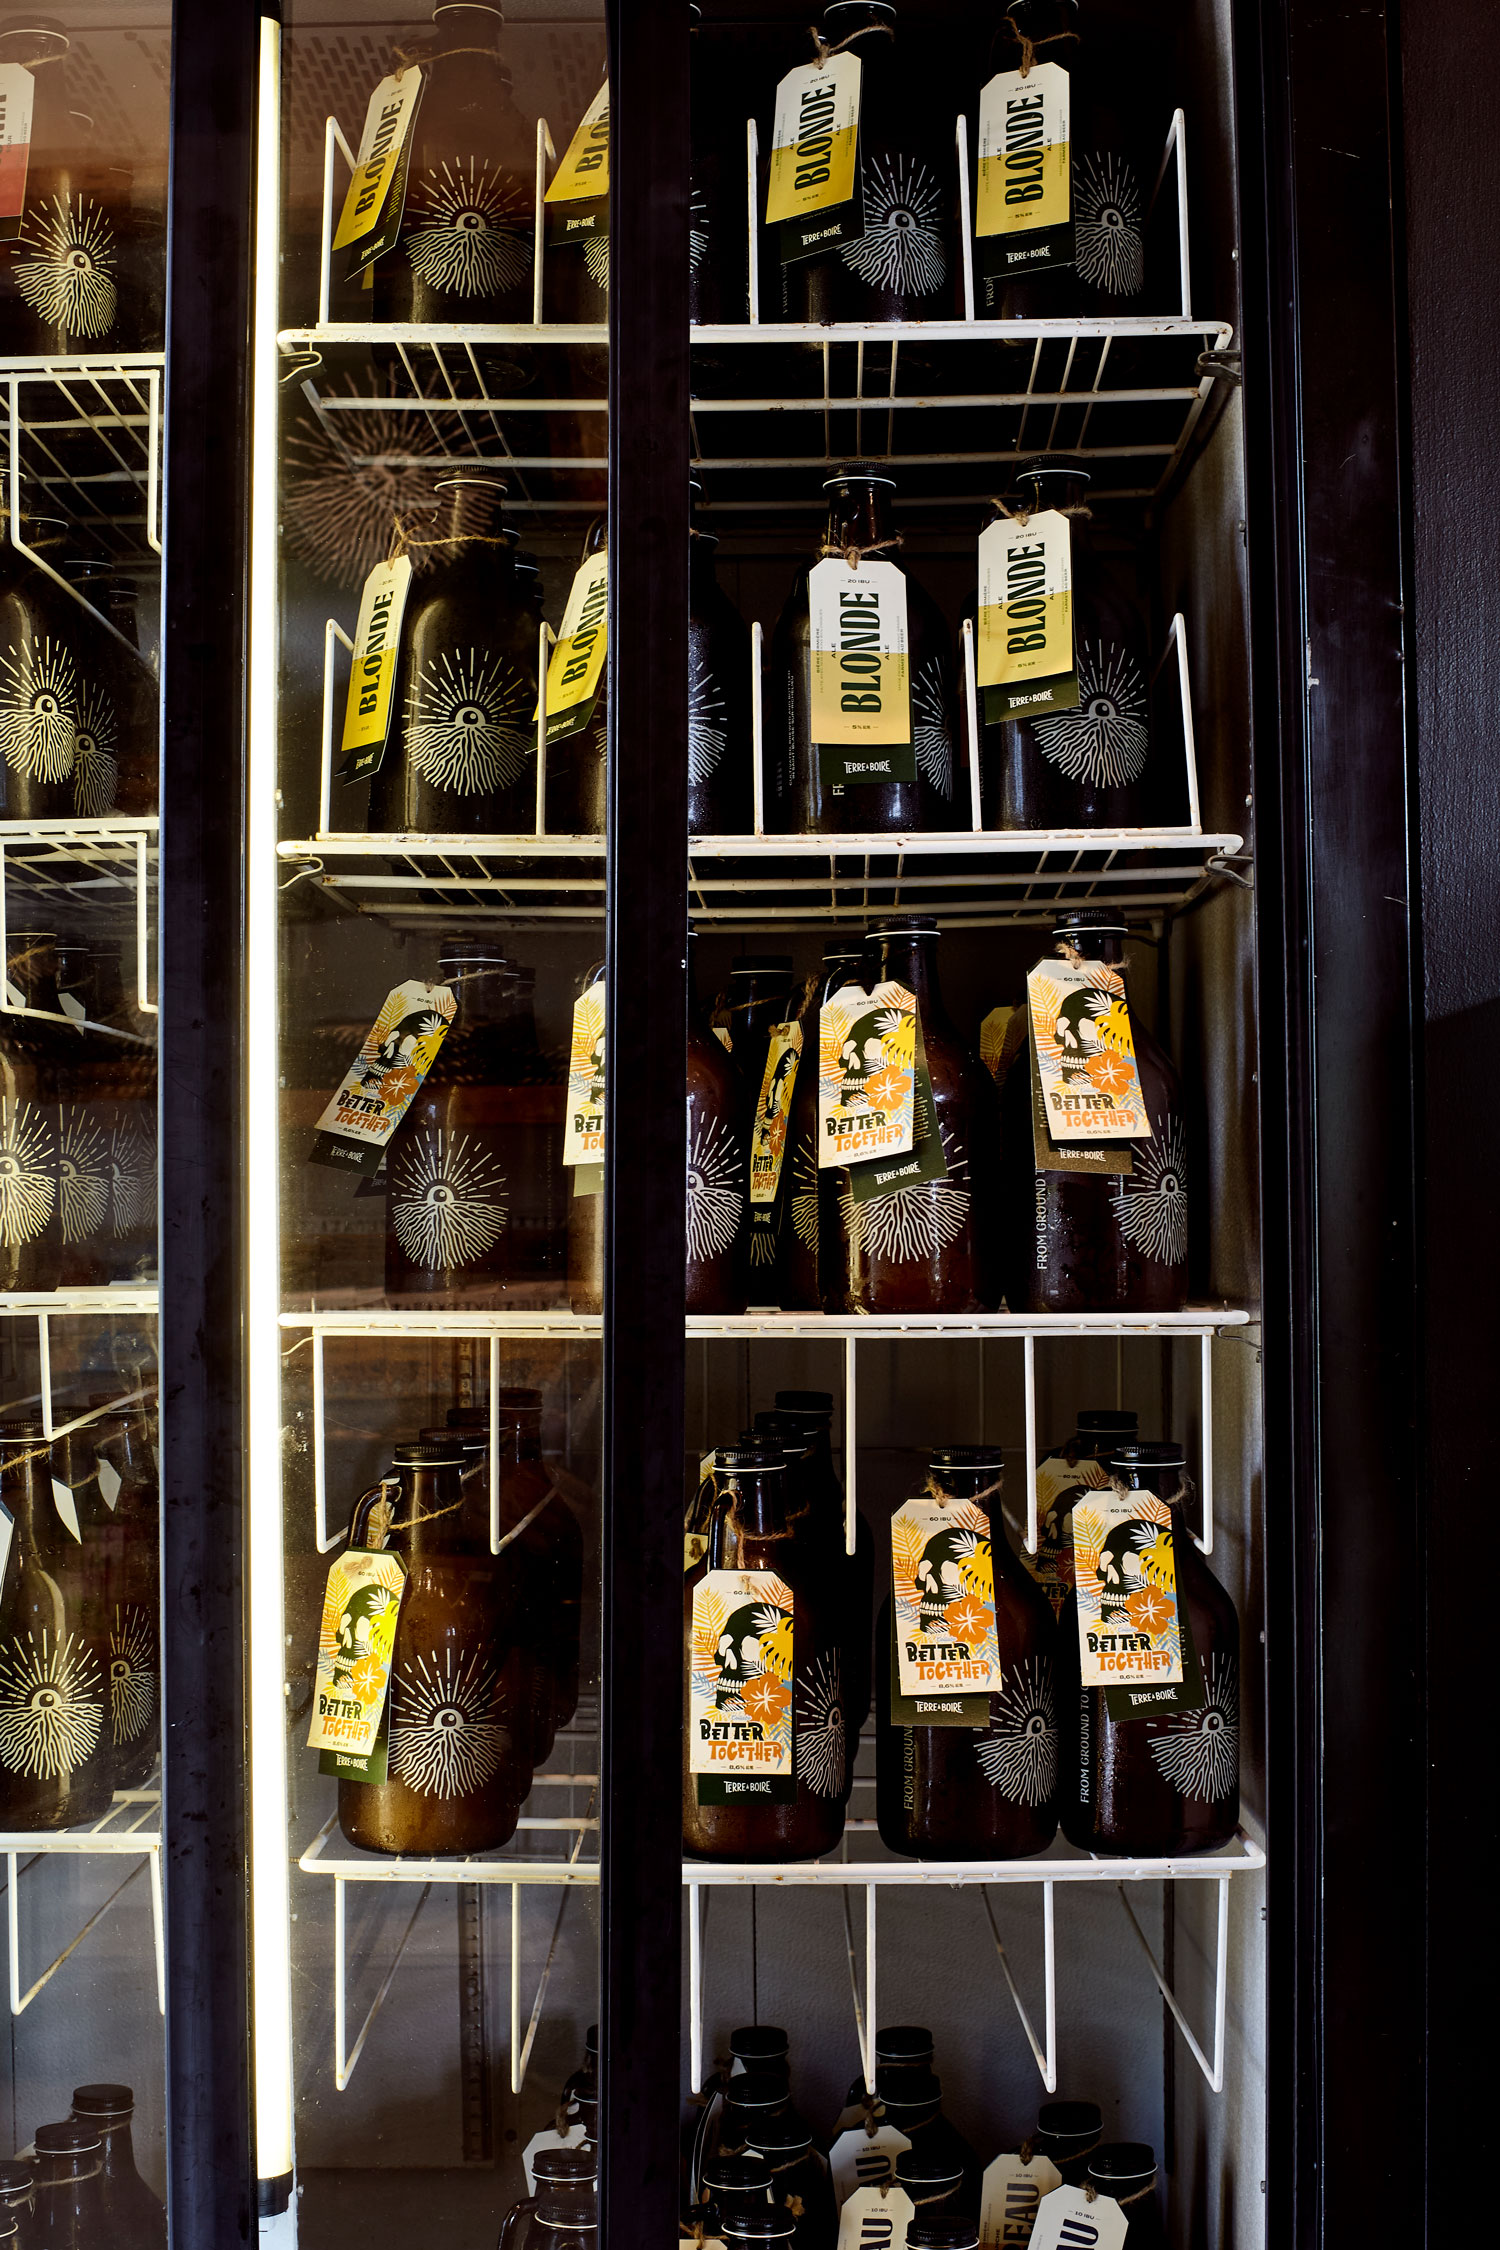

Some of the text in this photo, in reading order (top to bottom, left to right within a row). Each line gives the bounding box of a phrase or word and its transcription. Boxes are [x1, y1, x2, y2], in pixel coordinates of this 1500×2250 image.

[794, 83, 836, 191] BLONDE
[354, 98, 404, 217] BLONDE
[1005, 93, 1044, 206] BLONDE
[801, 224, 842, 246] TERRE BOIRE
[1006, 252, 1027, 264] TERRE
[1030, 245, 1051, 258] BOIRE
[1006, 542, 1046, 655] BLONDE
[561, 577, 608, 686] BLONDE
[359, 590, 394, 716] BLONDE
[839, 592, 882, 713] BLONDE
[1008, 696, 1030, 709] TERRE
[1032, 689, 1054, 702] BOIRE
[843, 761, 866, 774] TERRE
[870, 759, 891, 773] BOIRE
[336, 1089, 386, 1115] BETTER
[1050, 1093, 1115, 1110] BETTER
[334, 1106, 392, 1133] TOGETHER
[825, 1114, 886, 1136] BETTER
[1064, 1110, 1137, 1128] TOGETHER
[834, 1123, 904, 1153] TOGETHER
[1058, 1148, 1106, 1162] TERRE BOIRE
[874, 1161, 921, 1185] TERRE BOIRE
[1035, 1178, 1046, 1233] GROUND
[1036, 1237, 1047, 1270] FROM
[906, 1641, 970, 1662] BETTER
[1087, 1632, 1152, 1654] BETTER
[915, 1660, 991, 1681] TOGETHER
[1097, 1651, 1172, 1672] TOGETHER
[915, 1701, 964, 1714] TERRE BOIRE
[1080, 1693, 1090, 1708] TO
[1128, 1691, 1152, 1706] TERRE
[1155, 1687, 1179, 1701] BOIRE
[319, 1695, 363, 1721] BETTER
[322, 1715, 372, 1741] TOGETHER
[700, 1719, 764, 1741] BETTER
[1079, 1713, 1091, 1767] GROUND
[336, 1753, 369, 1772] TERRE BOIRE
[708, 1741, 783, 1763] TOGETHER
[723, 1780, 746, 1793] TERRE
[750, 1780, 772, 1794] BOIRE
[903, 1771, 914, 1810] FROM
[1079, 1769, 1091, 1803] FROM
